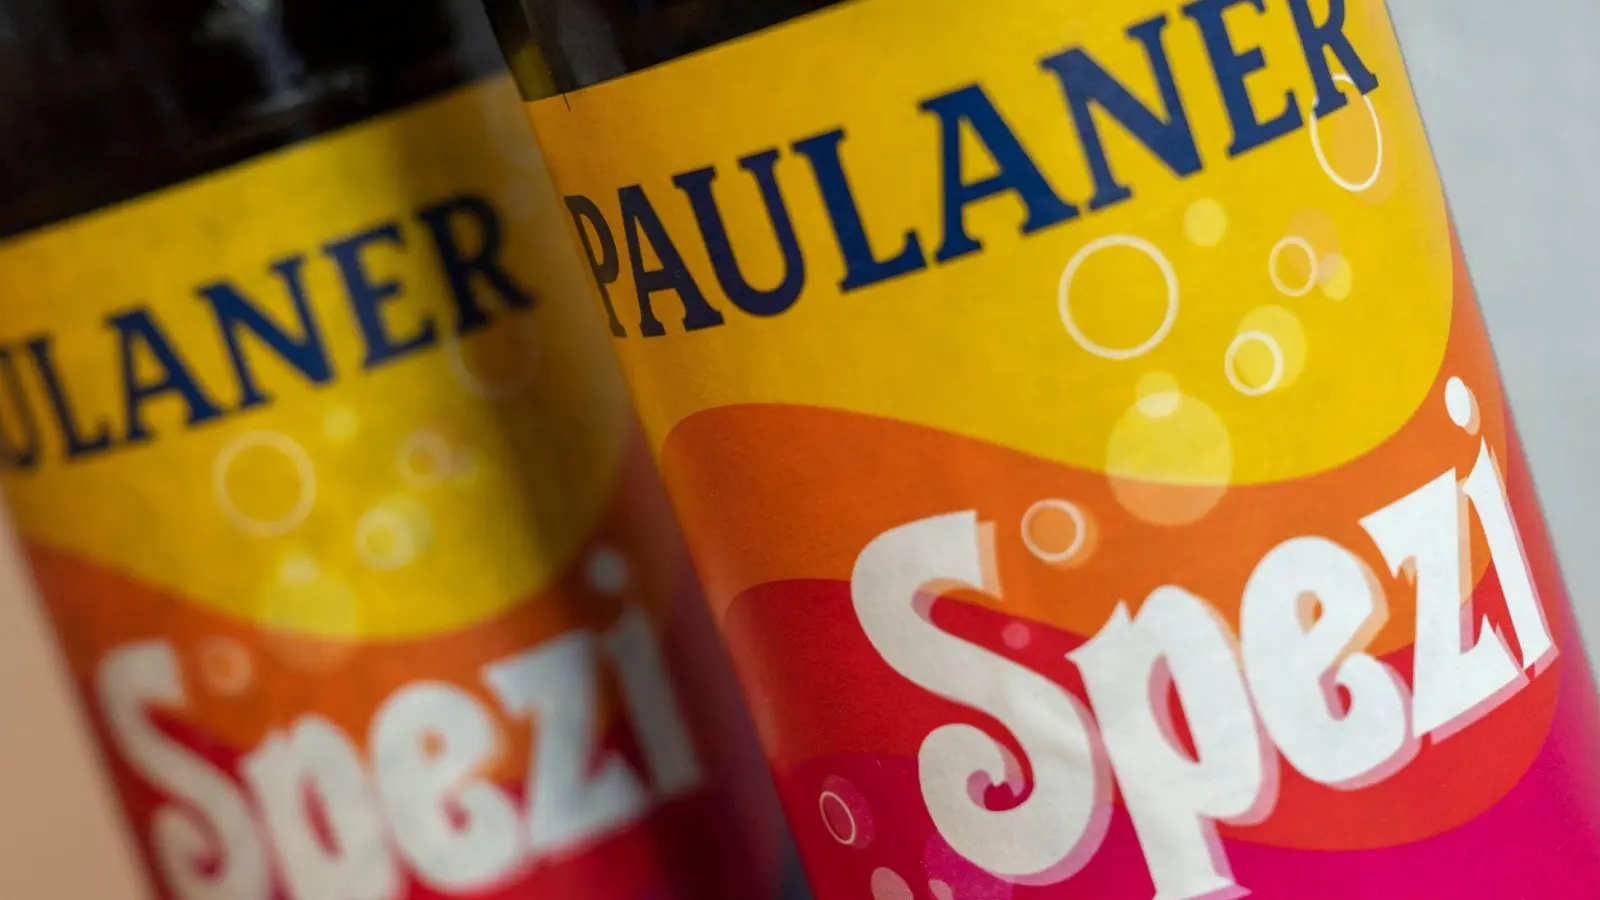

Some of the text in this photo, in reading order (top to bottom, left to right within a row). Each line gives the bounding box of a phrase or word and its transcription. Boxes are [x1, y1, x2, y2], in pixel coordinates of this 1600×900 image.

[563, 0, 1379, 338] PAULANER
[94, 547, 702, 900] Spezi
[850, 376, 1558, 900] Spezi
